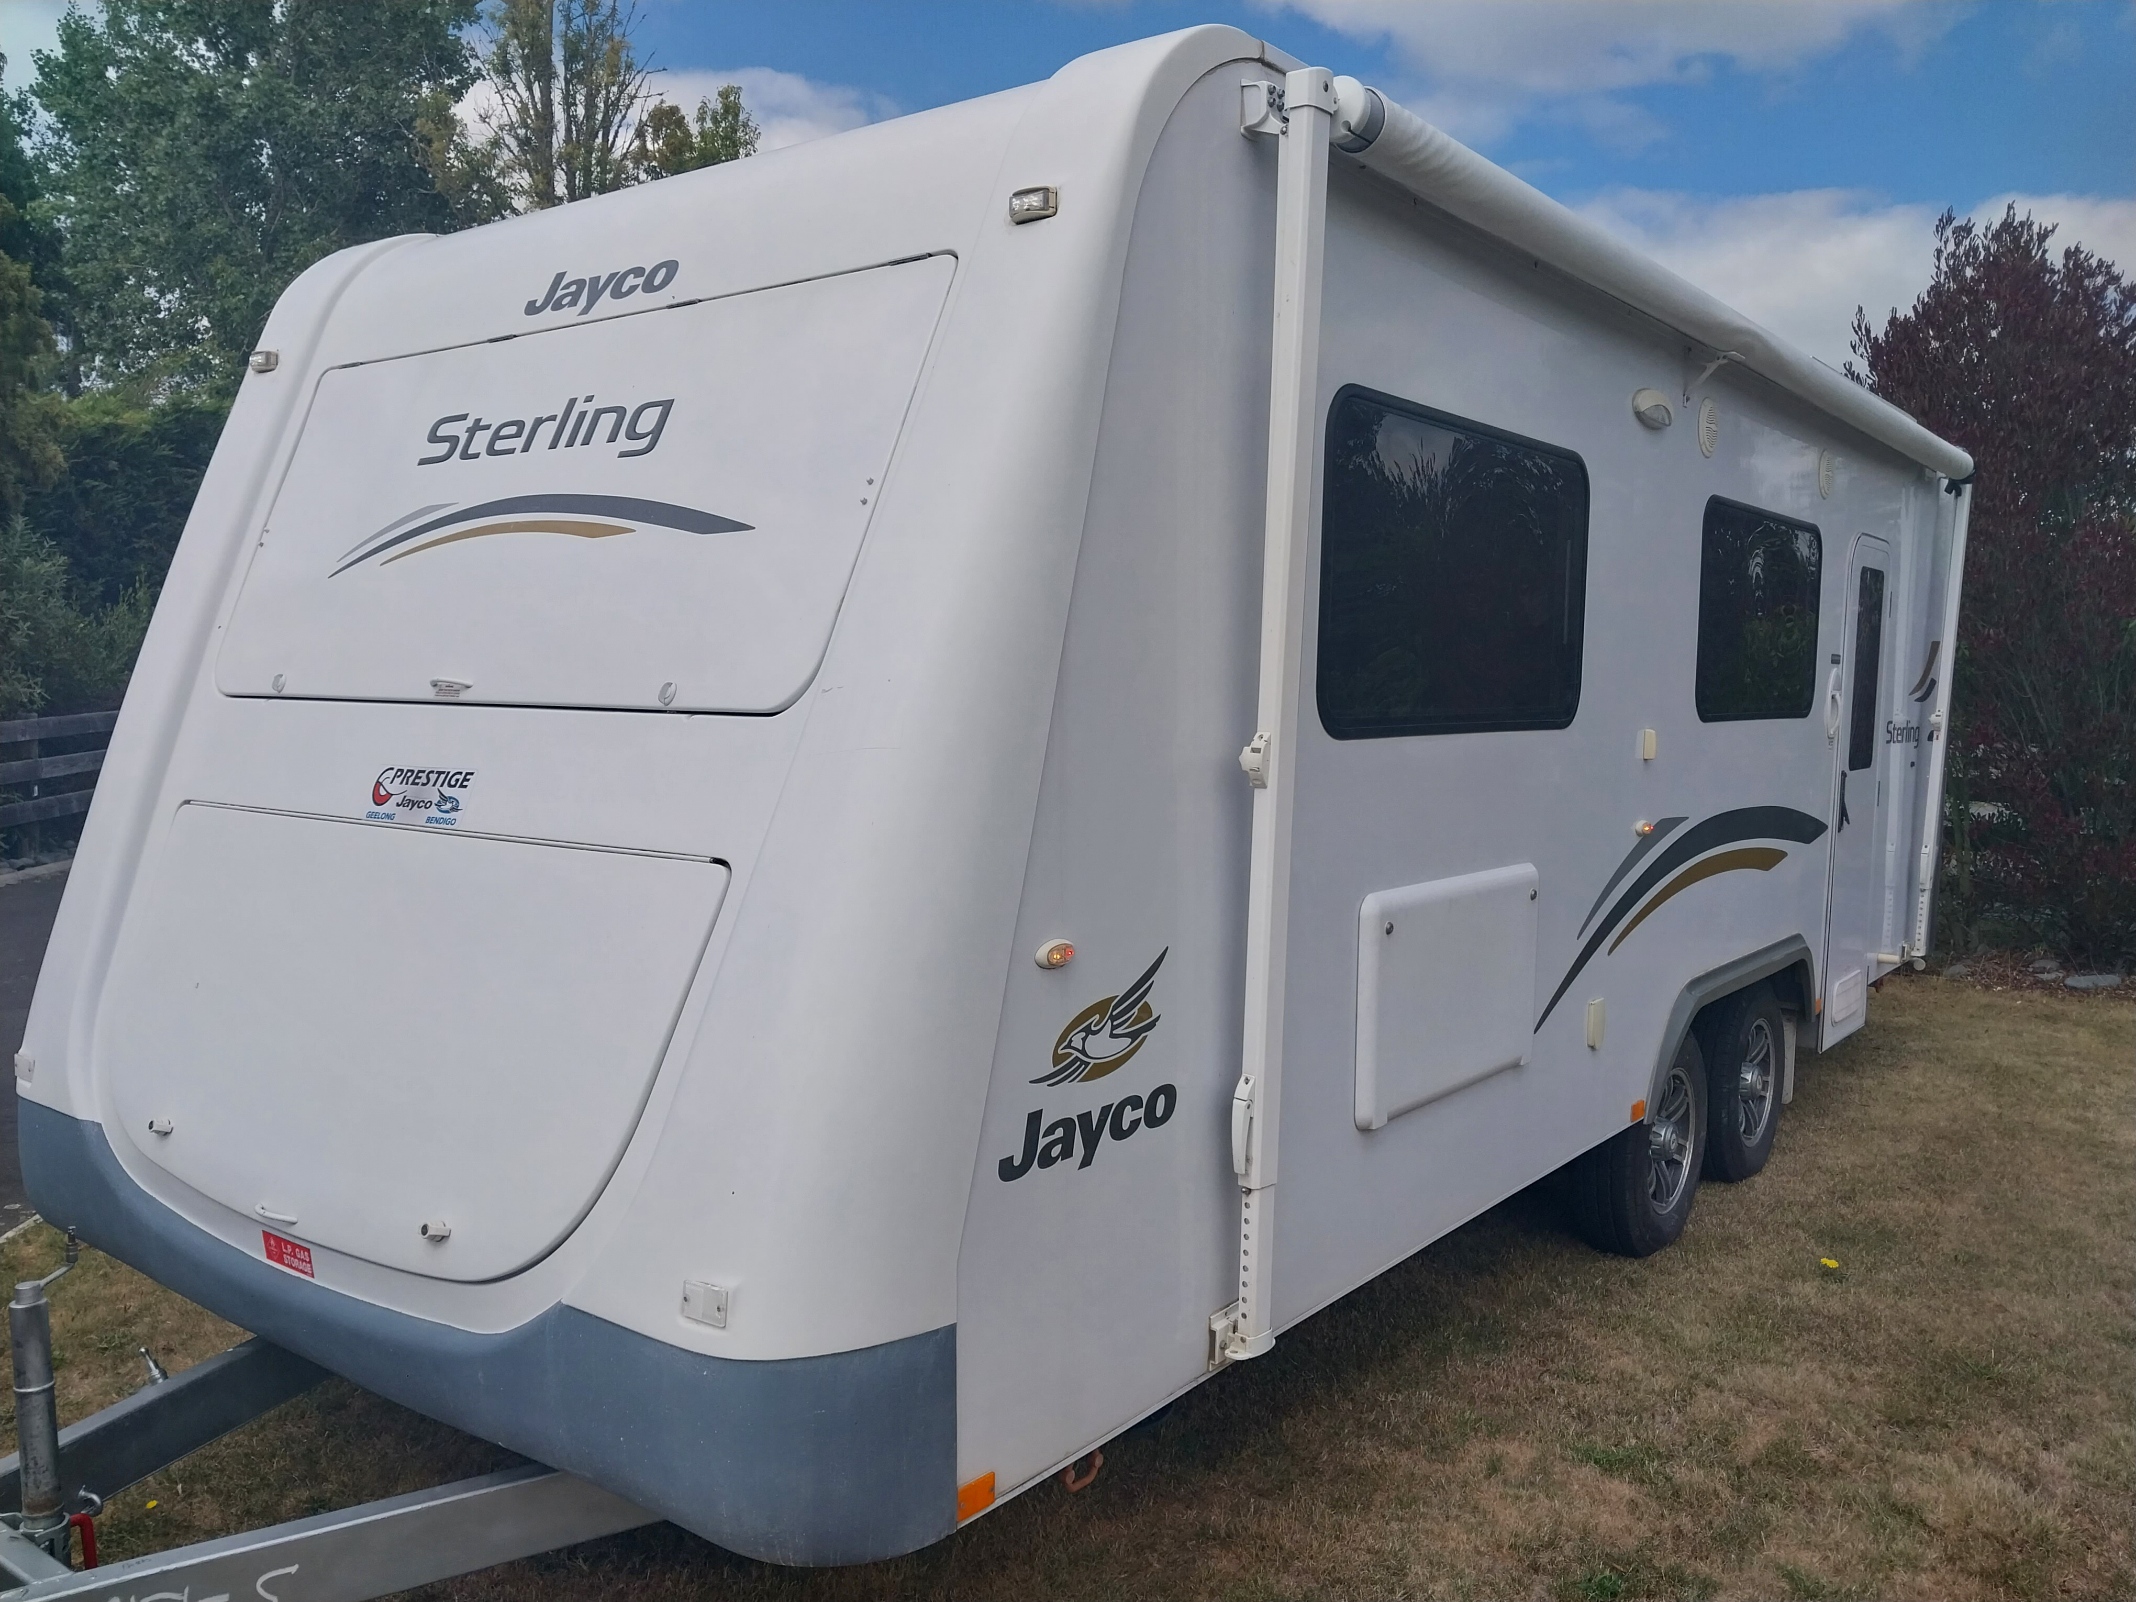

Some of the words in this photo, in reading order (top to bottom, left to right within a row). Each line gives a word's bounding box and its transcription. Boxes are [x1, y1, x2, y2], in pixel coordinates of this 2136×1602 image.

[523, 259, 679, 316] Jayco
[417, 395, 675, 467] Sterling
[1886, 720, 1920, 749] Sterling
[389, 768, 475, 789] PRESTIGE
[395, 796, 433, 811] Jayco
[365, 811, 396, 821] GEELONG
[425, 816, 457, 826] BENDIGO
[998, 1083, 1177, 1182] Jayco
[283, 1253, 312, 1274] STORAGE
[295, 1247, 310, 1262] GAS
